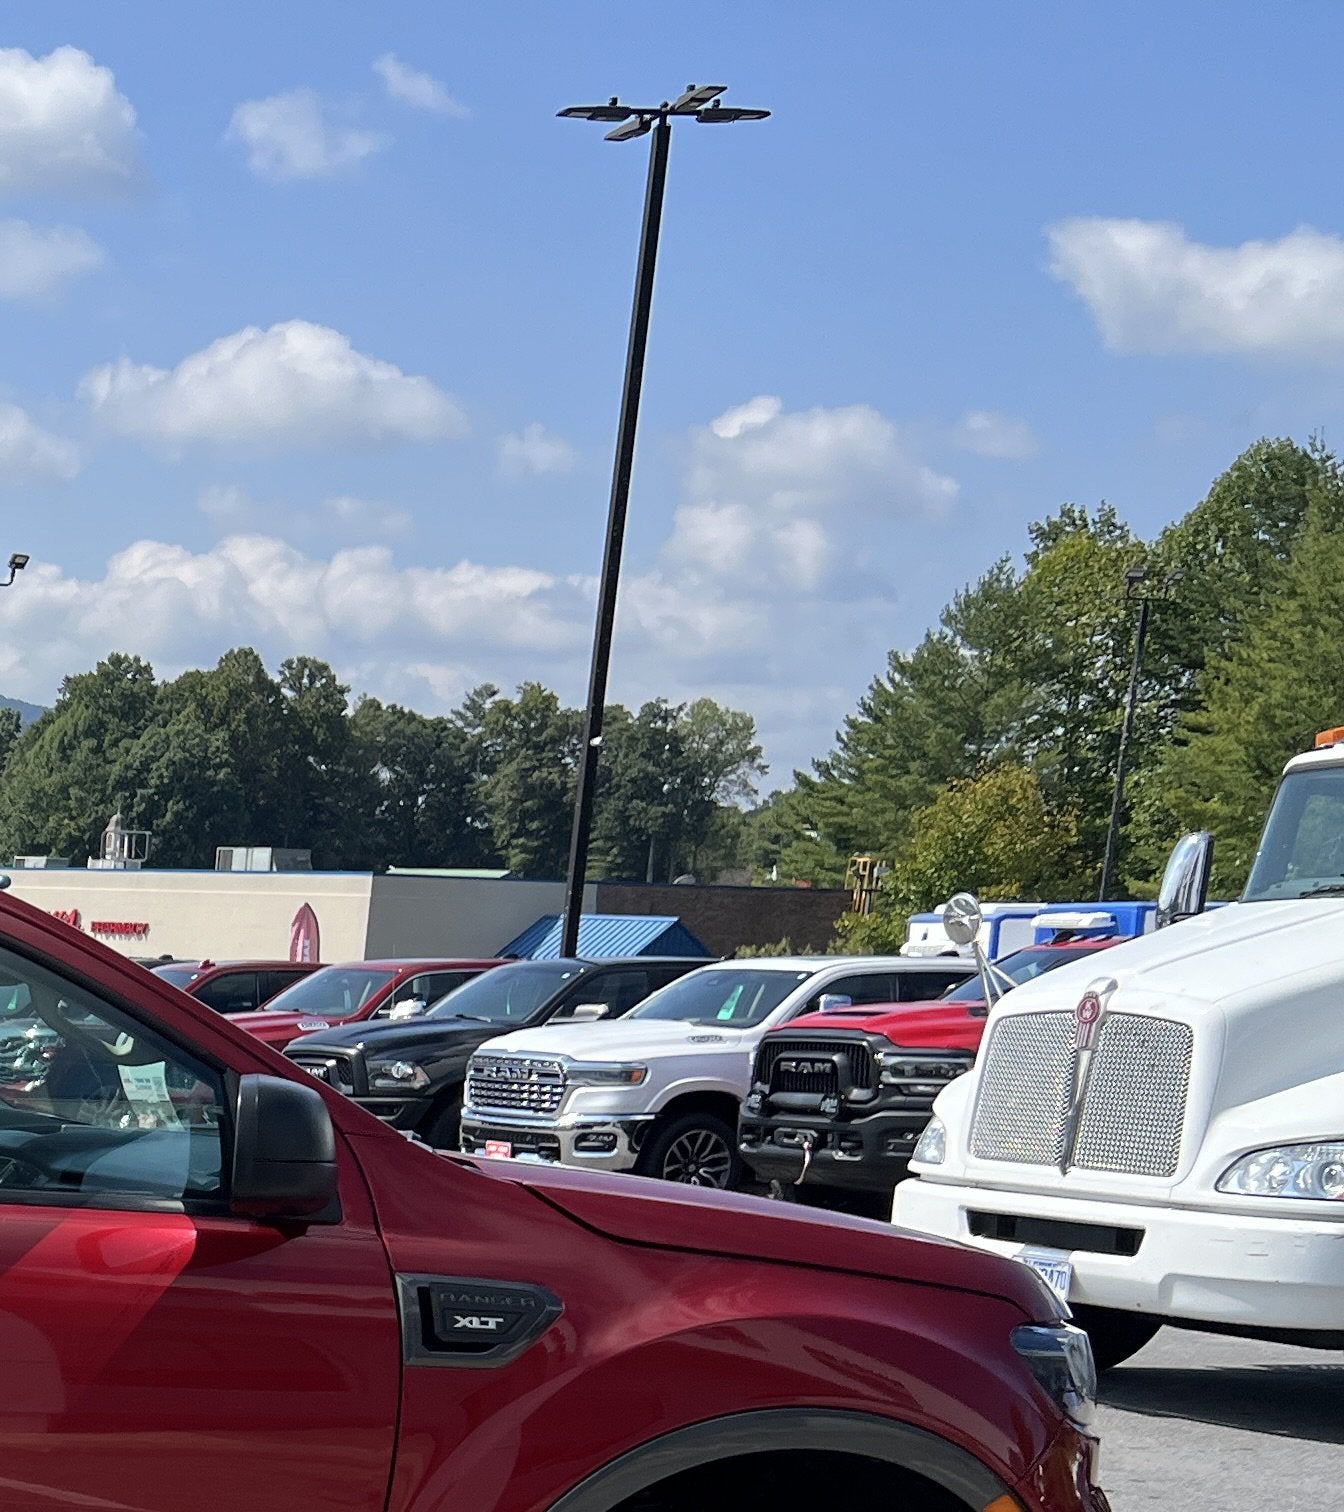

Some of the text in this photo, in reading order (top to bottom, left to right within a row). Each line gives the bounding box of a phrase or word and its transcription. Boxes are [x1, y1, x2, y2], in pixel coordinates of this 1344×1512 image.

[91, 921, 150, 935] PHARMACY
[780, 1060, 833, 1073] RAM
[453, 1314, 505, 1331] XLT
